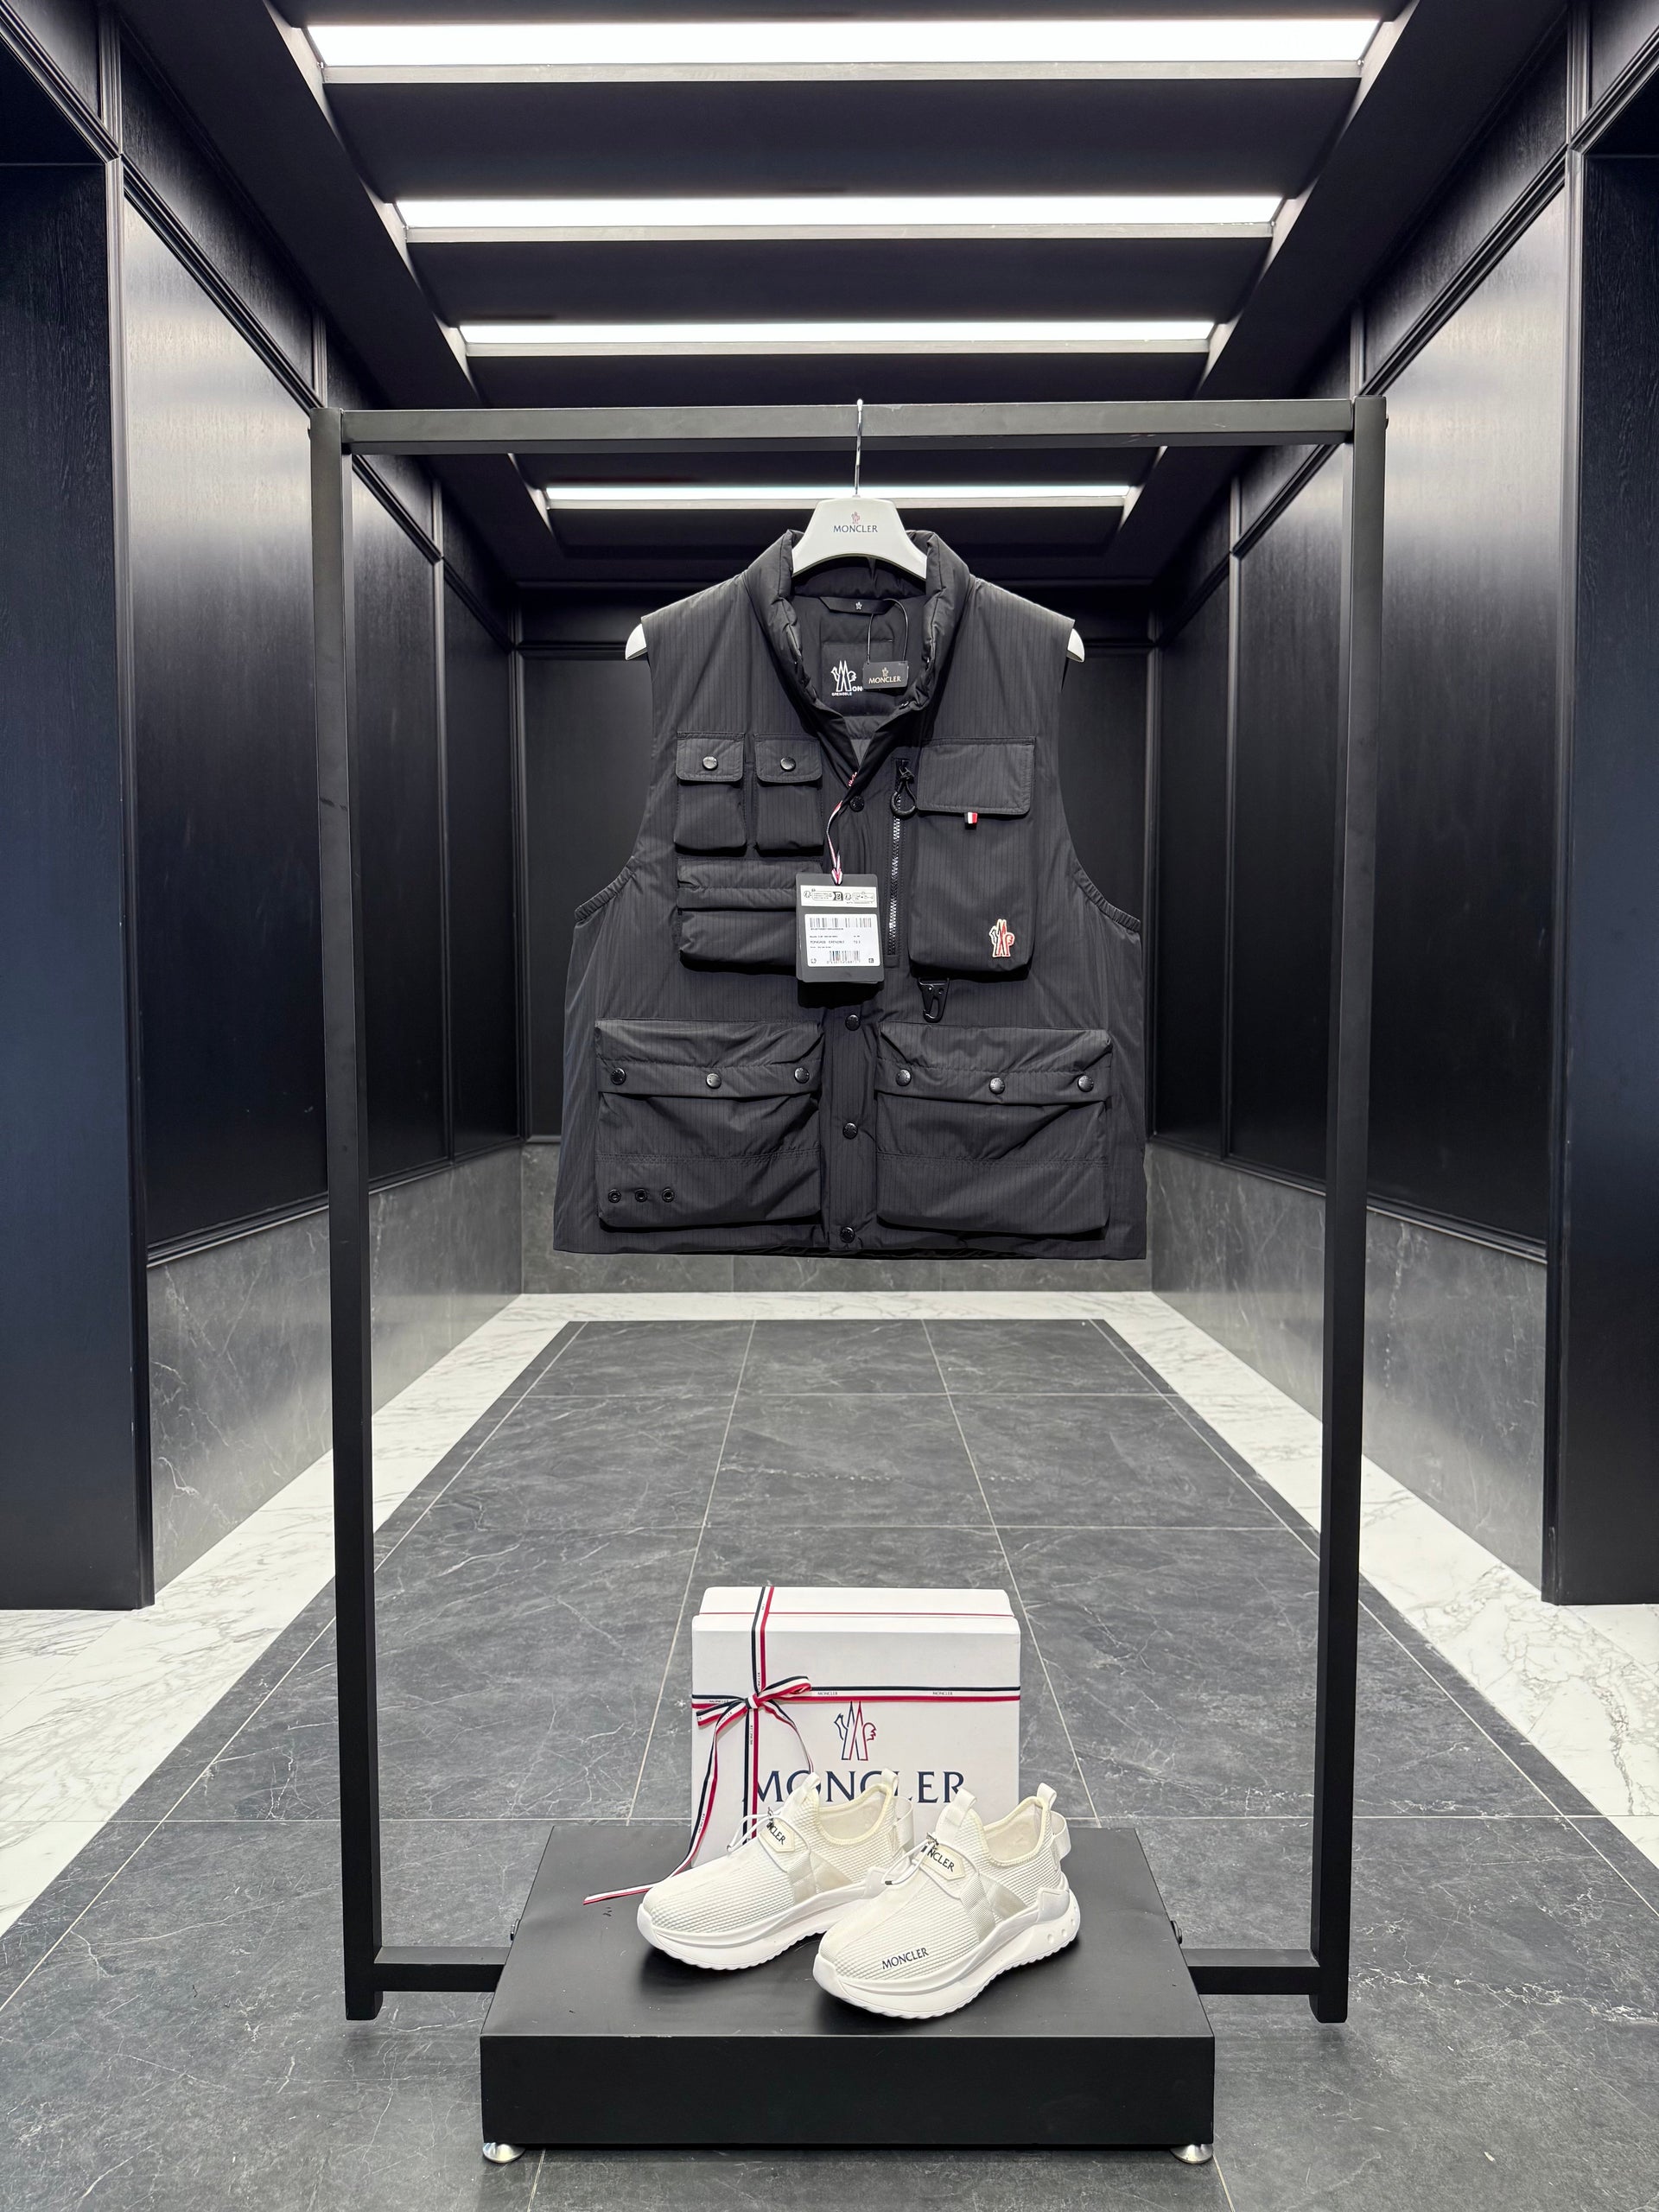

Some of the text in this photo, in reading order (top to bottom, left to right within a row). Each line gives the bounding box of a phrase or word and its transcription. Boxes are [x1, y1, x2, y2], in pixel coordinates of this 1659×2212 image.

[833, 524, 879, 533] MONCLER
[868, 676, 901, 684] MONCLER
[881, 1947, 929, 1970] MONCLER
